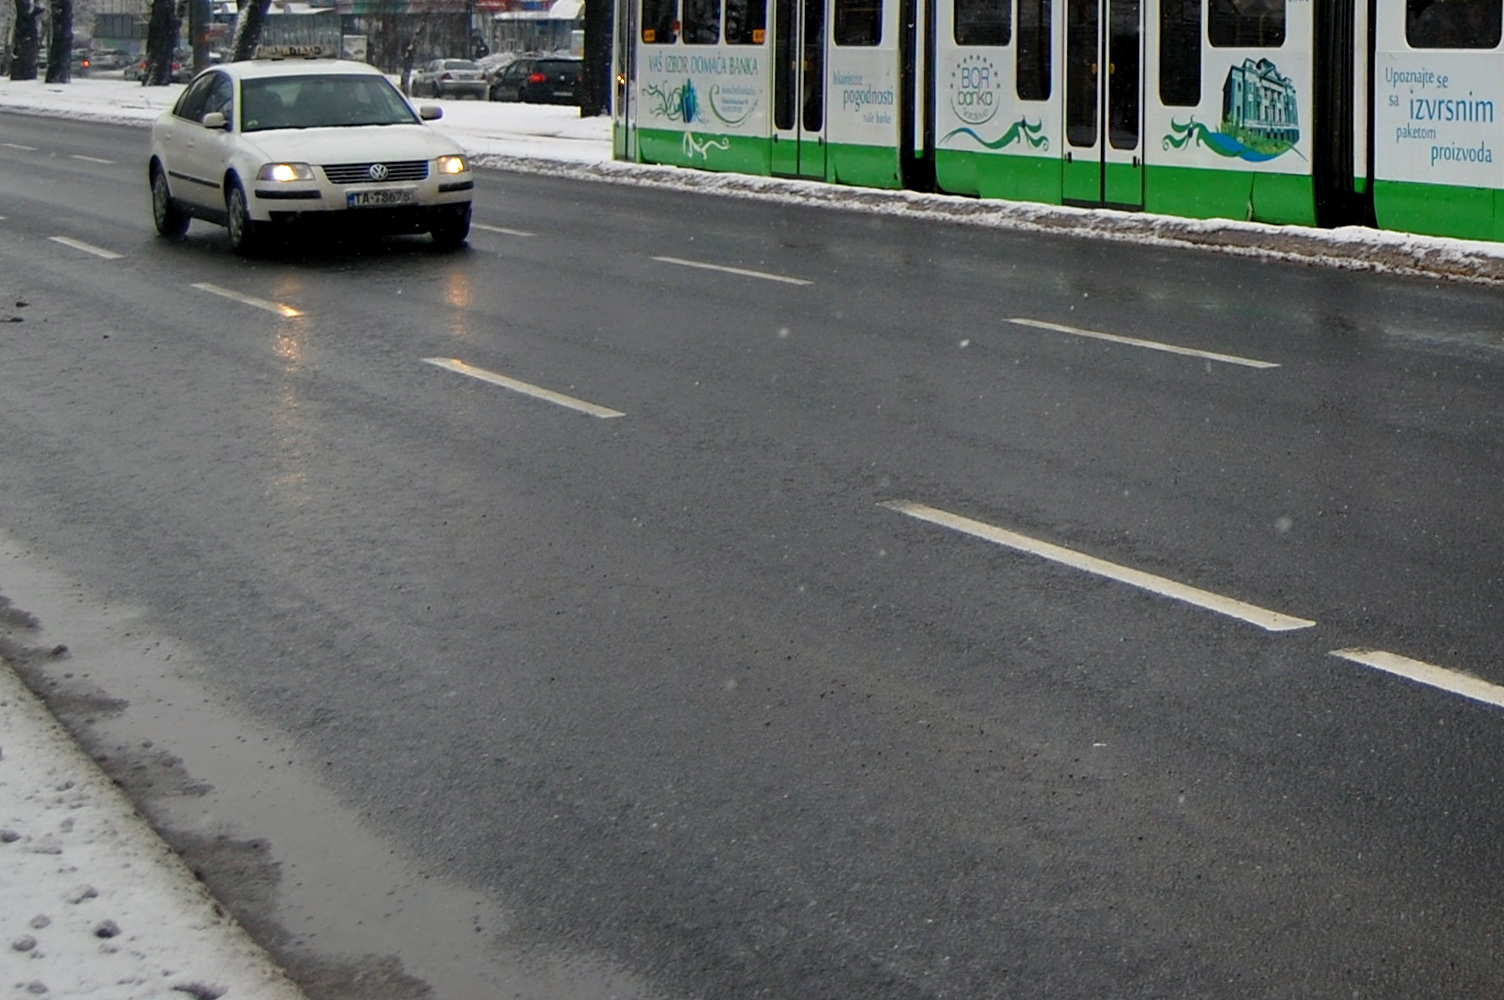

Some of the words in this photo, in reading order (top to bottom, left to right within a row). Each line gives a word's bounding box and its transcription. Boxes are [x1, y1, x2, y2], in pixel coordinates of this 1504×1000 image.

[665, 55, 689, 73] IZBOR
[729, 56, 759, 76] BANKA
[961, 67, 990, 89] BOR
[1385, 66, 1435, 89] Upoznajte
[1436, 74, 1449, 89] se
[843, 83, 894, 112] pogodnosti
[957, 87, 993, 106] banka
[1388, 94, 1400, 107] sa
[1409, 89, 1494, 123] izvrsnim
[1396, 122, 1436, 144] paketom
[1431, 140, 1493, 168] proizvoda
